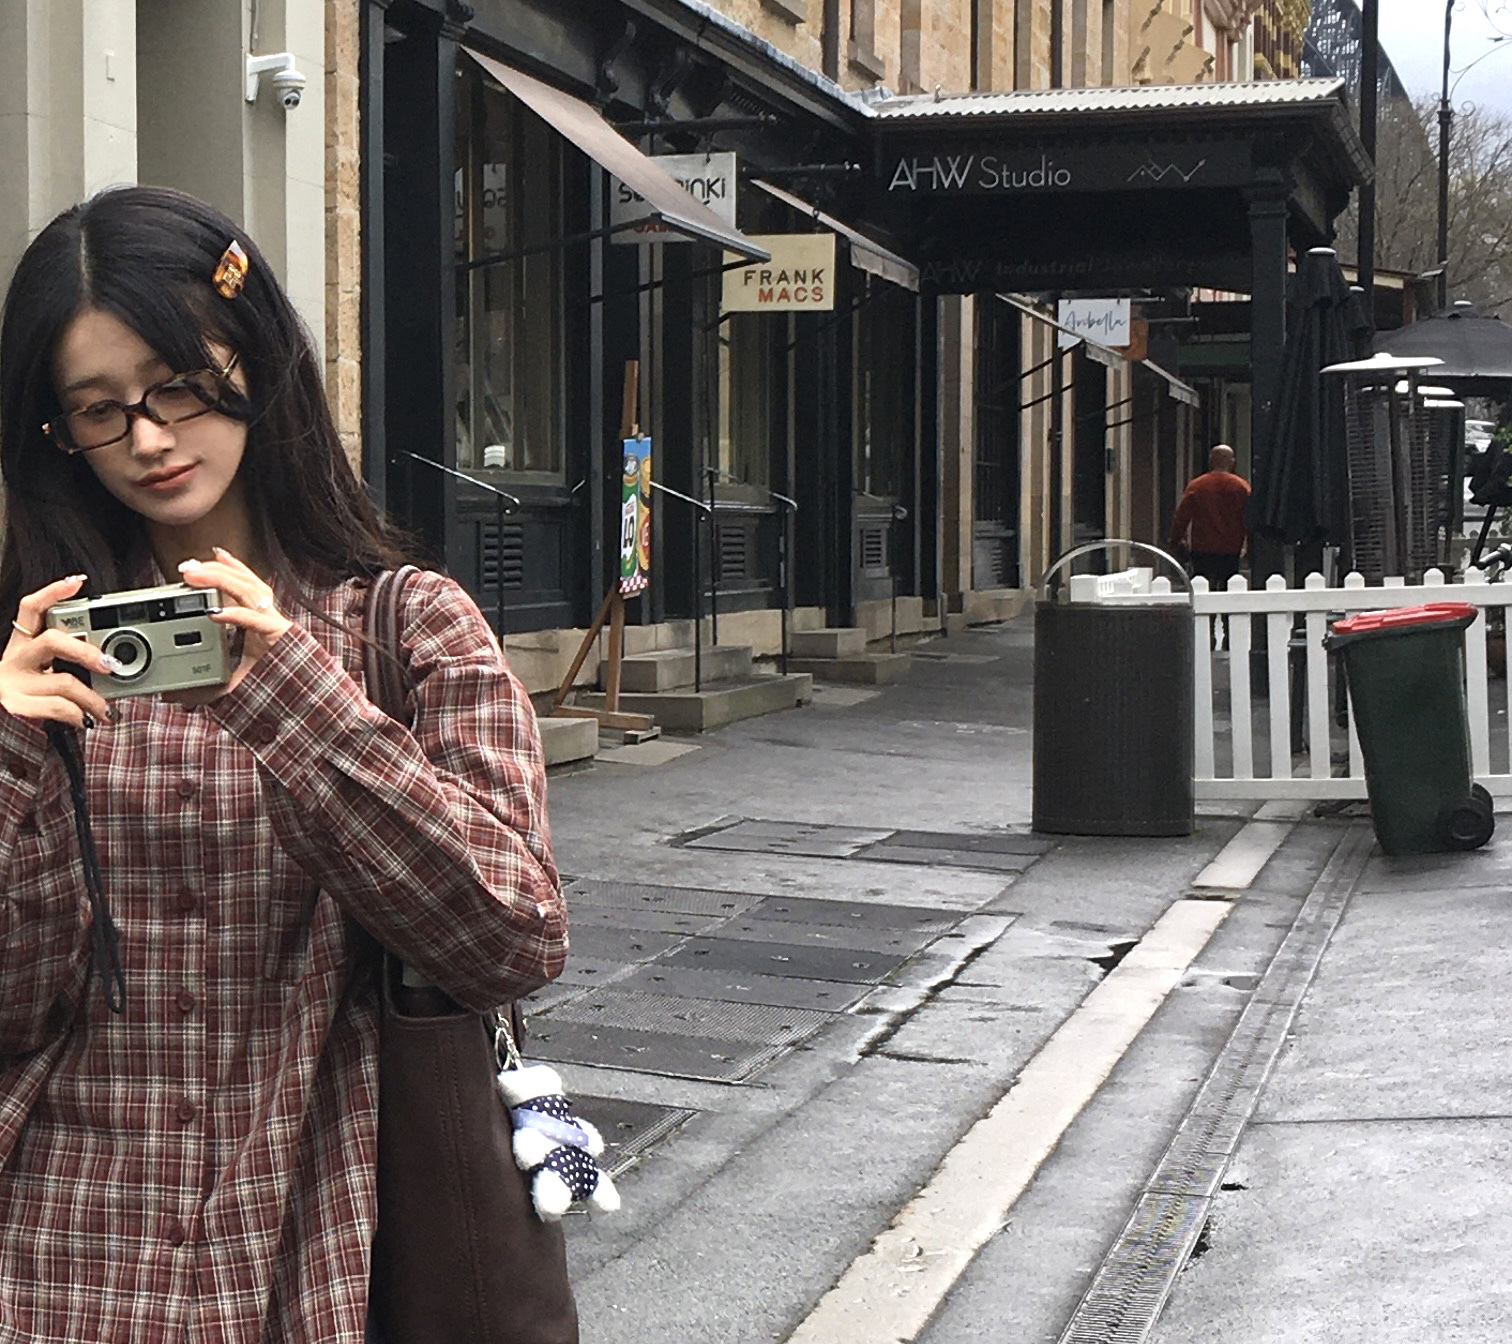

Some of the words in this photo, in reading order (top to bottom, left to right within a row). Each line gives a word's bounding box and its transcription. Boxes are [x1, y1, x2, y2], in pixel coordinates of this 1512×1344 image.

[888, 155, 974, 191] AHW
[978, 155, 1071, 189] Studio
[743, 268, 825, 286] FRANK
[758, 286, 824, 303] MACS
